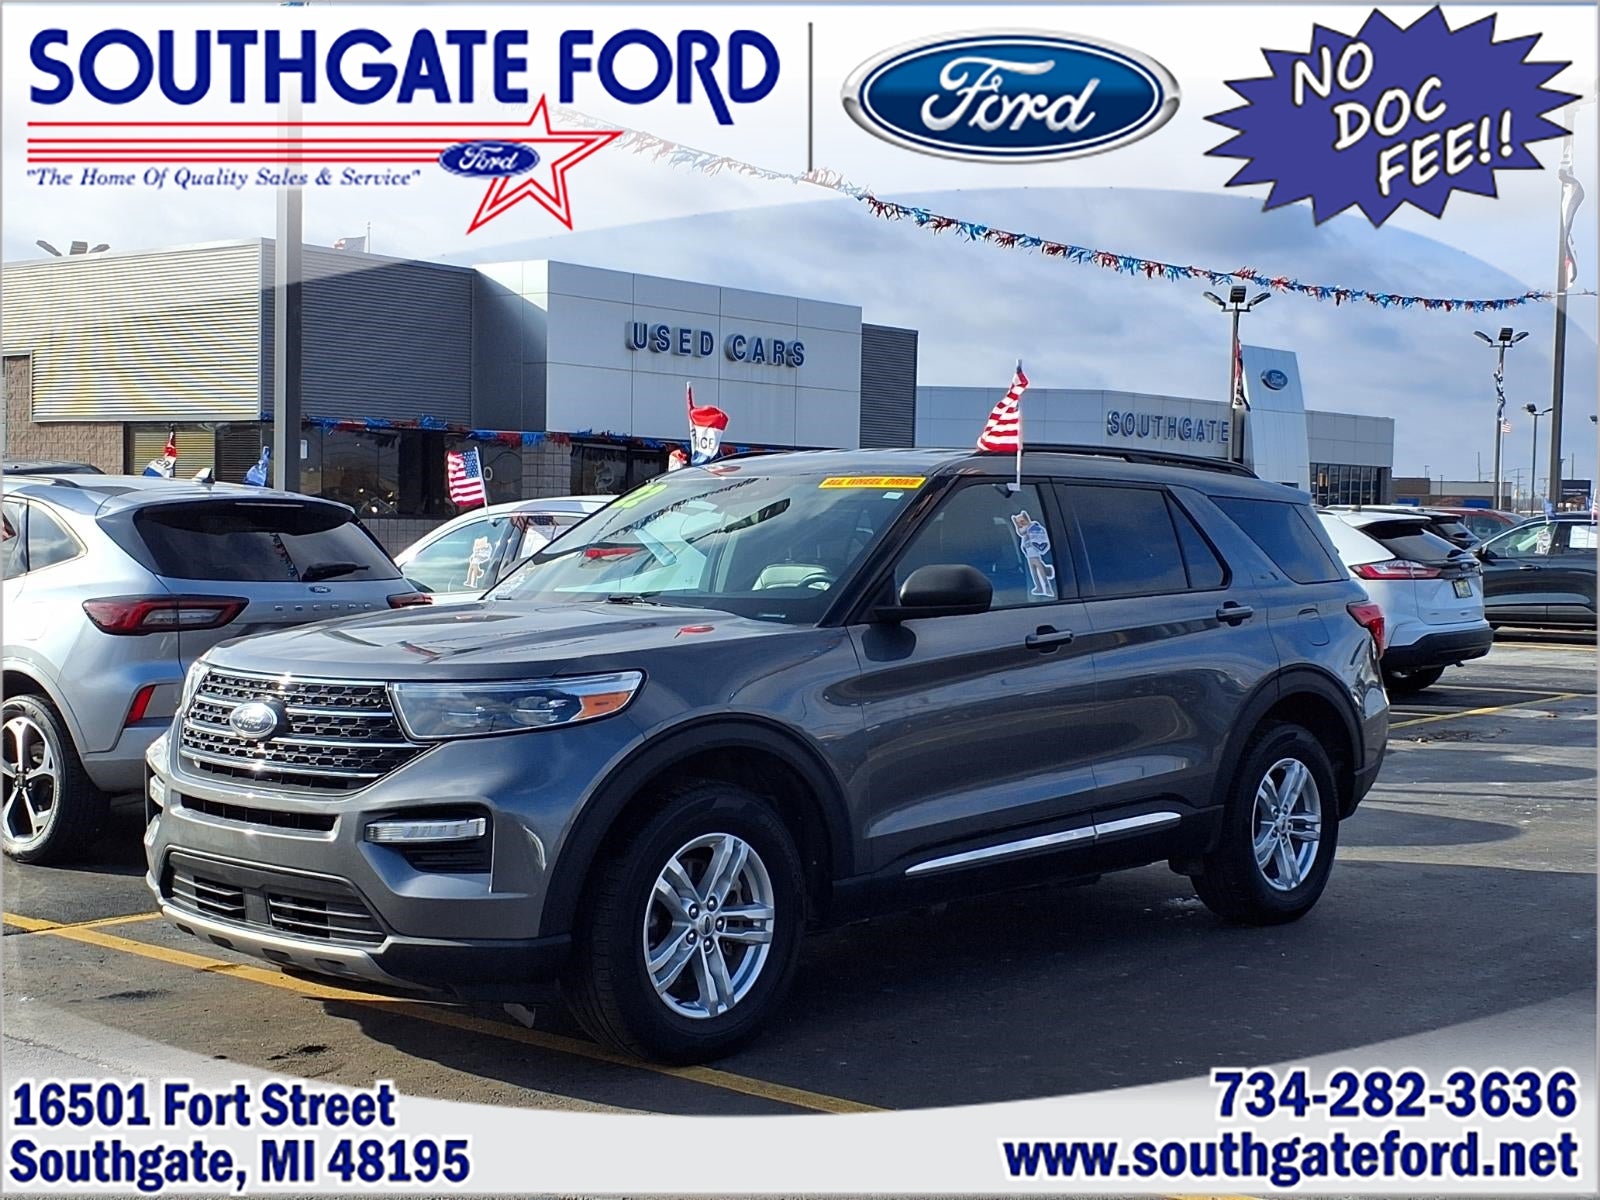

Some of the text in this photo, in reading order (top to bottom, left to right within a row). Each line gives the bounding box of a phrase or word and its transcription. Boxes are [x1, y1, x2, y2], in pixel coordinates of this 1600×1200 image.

[629, 321, 805, 367] USED CARS
[1107, 410, 1229, 442] SOUTHGATE
